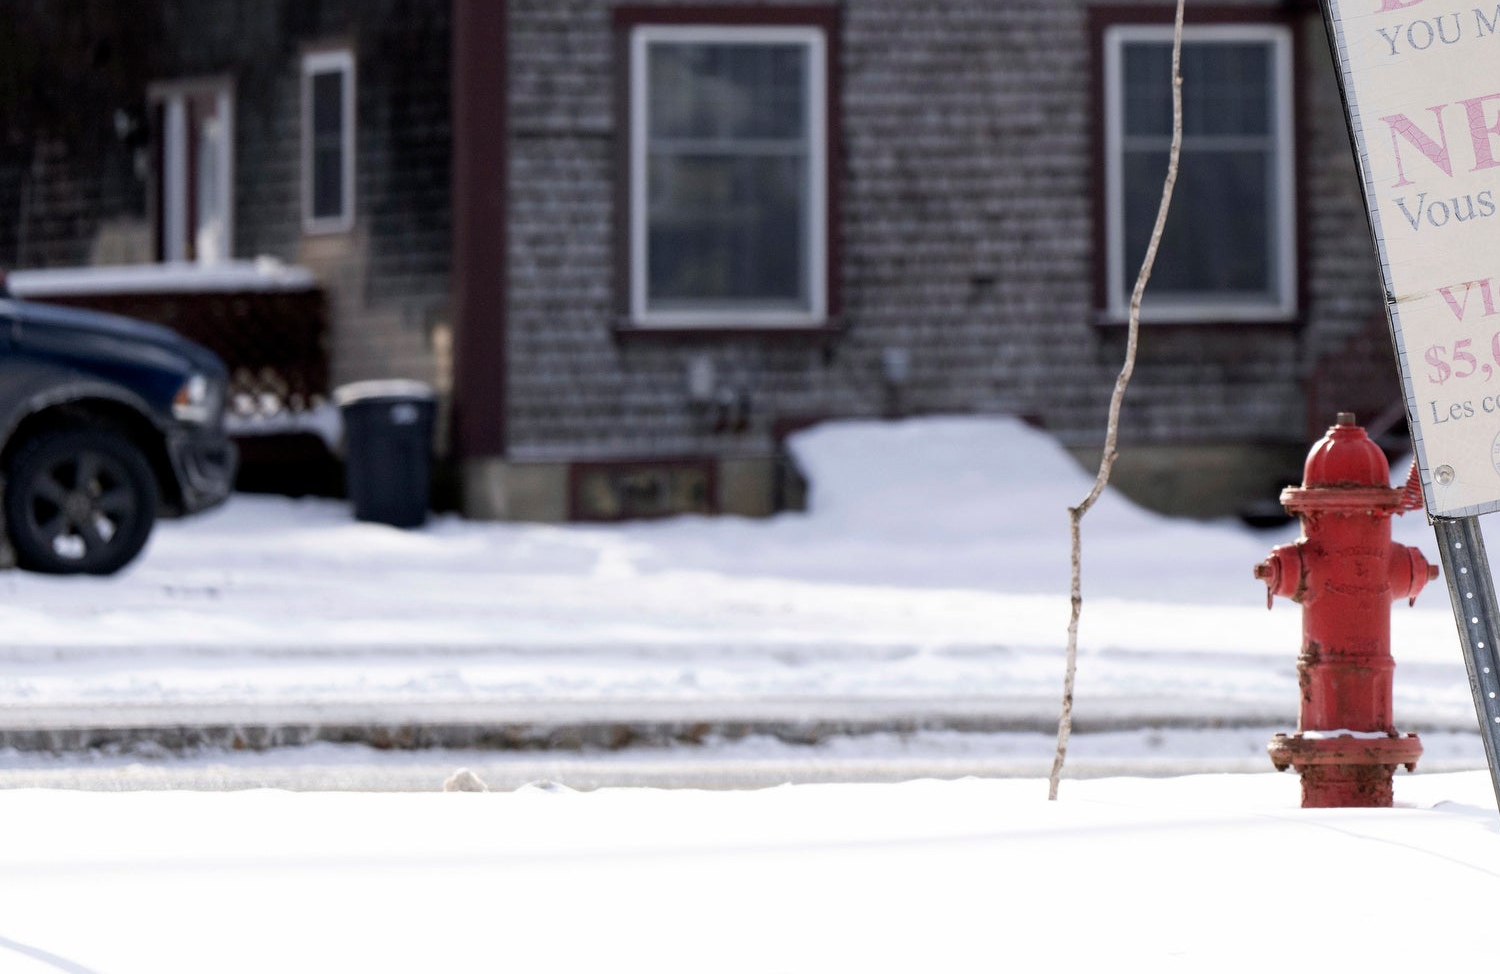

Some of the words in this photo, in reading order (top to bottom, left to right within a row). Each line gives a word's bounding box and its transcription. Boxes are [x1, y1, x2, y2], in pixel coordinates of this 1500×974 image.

[1376, 12, 1461, 56] YOU
[1392, 190, 1496, 232] Vous
[1429, 399, 1475, 425] Les
